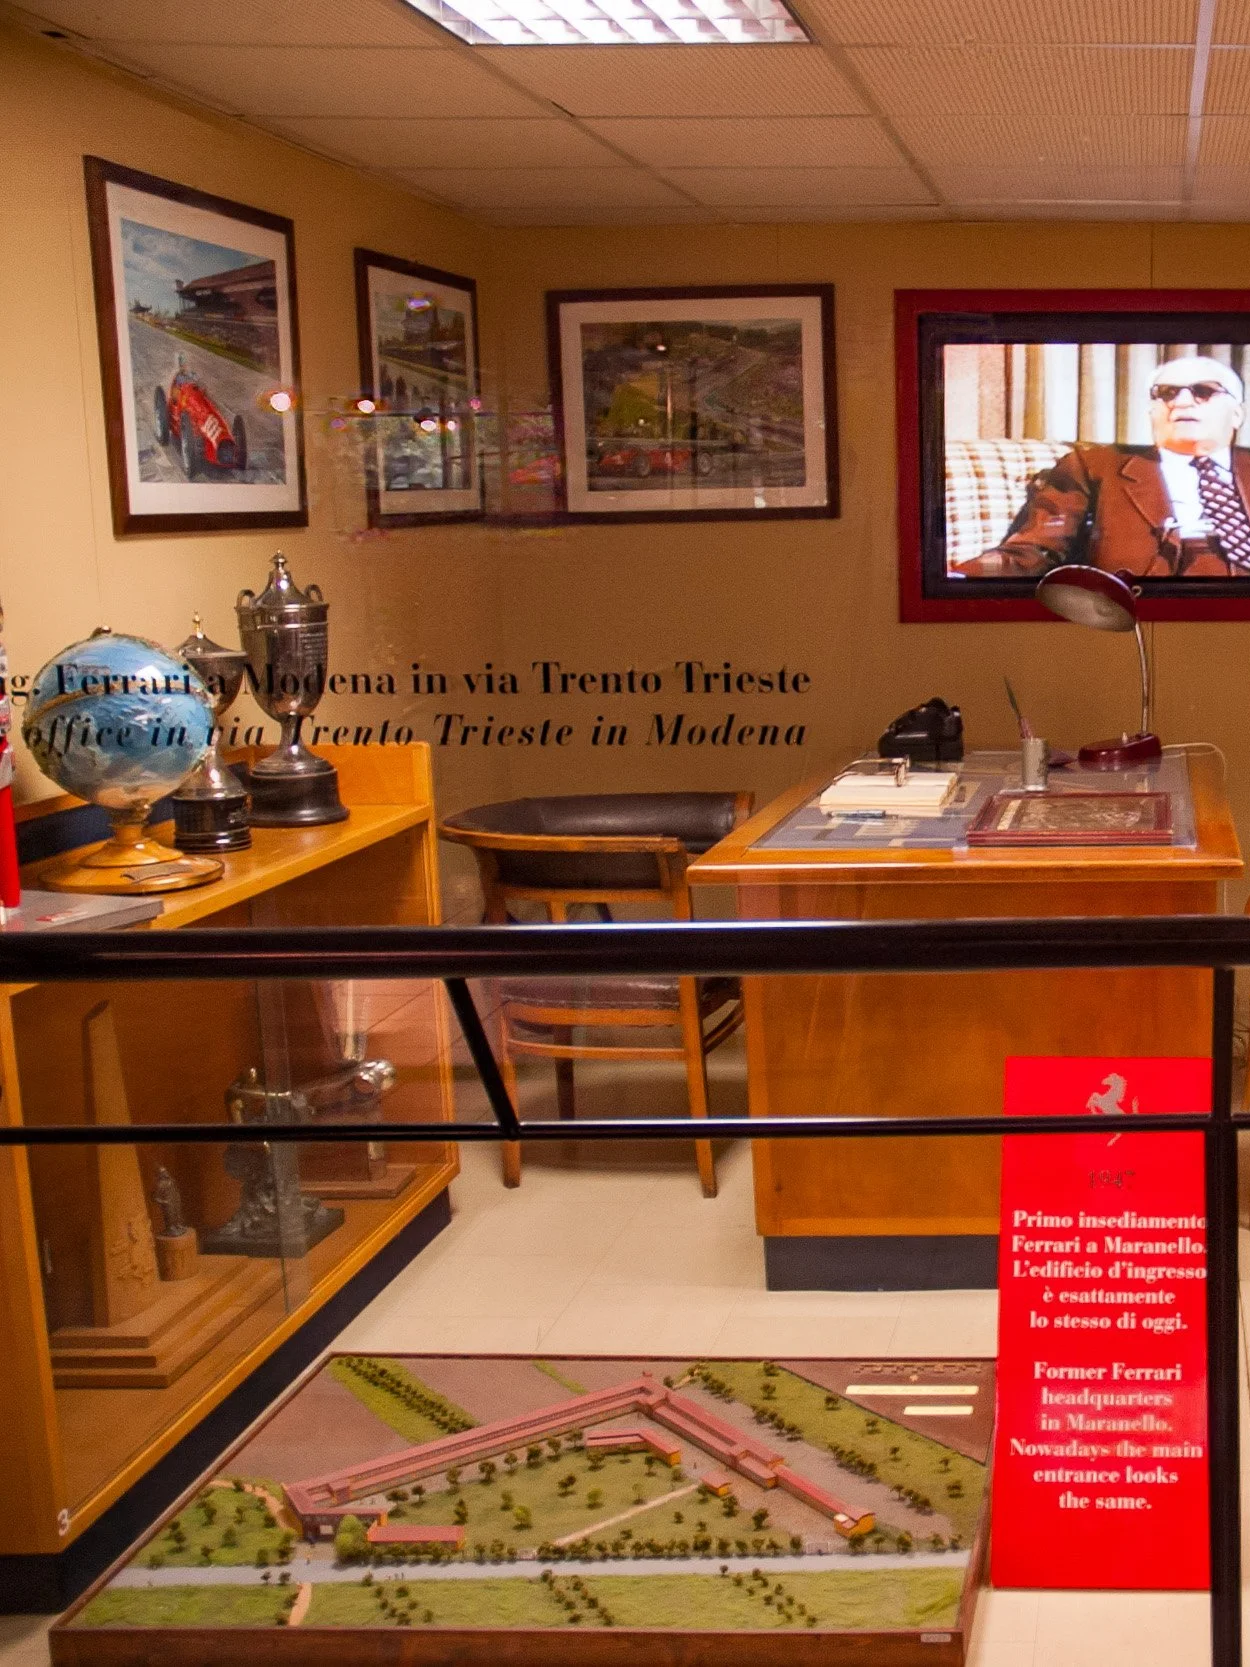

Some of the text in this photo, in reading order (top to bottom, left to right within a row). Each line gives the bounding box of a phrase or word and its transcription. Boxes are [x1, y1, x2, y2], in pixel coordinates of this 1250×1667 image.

[0, 661, 812, 707] g. Ferrari a Modena in via Trento Trieste
[23, 712, 808, 758] office in via Trento Trieste in Modena
[1012, 1210, 1207, 1229] Primo insediamento
[1011, 1235, 1207, 1254] Ferrari a Maranello.
[1042, 1286, 1176, 1305] è esattamente
[1029, 1311, 1188, 1334] lo stesso di oggi.
[1033, 1361, 1182, 1381] Former Ferrari
[1041, 1387, 1173, 1411] headquarters
[1041, 1413, 1173, 1431] in Maranello.
[1010, 1438, 1204, 1462] Nowadays the main
[1033, 1466, 1179, 1484] entrance looks
[1059, 1491, 1152, 1510] the same.
[57, 1508, 71, 1537] 3
